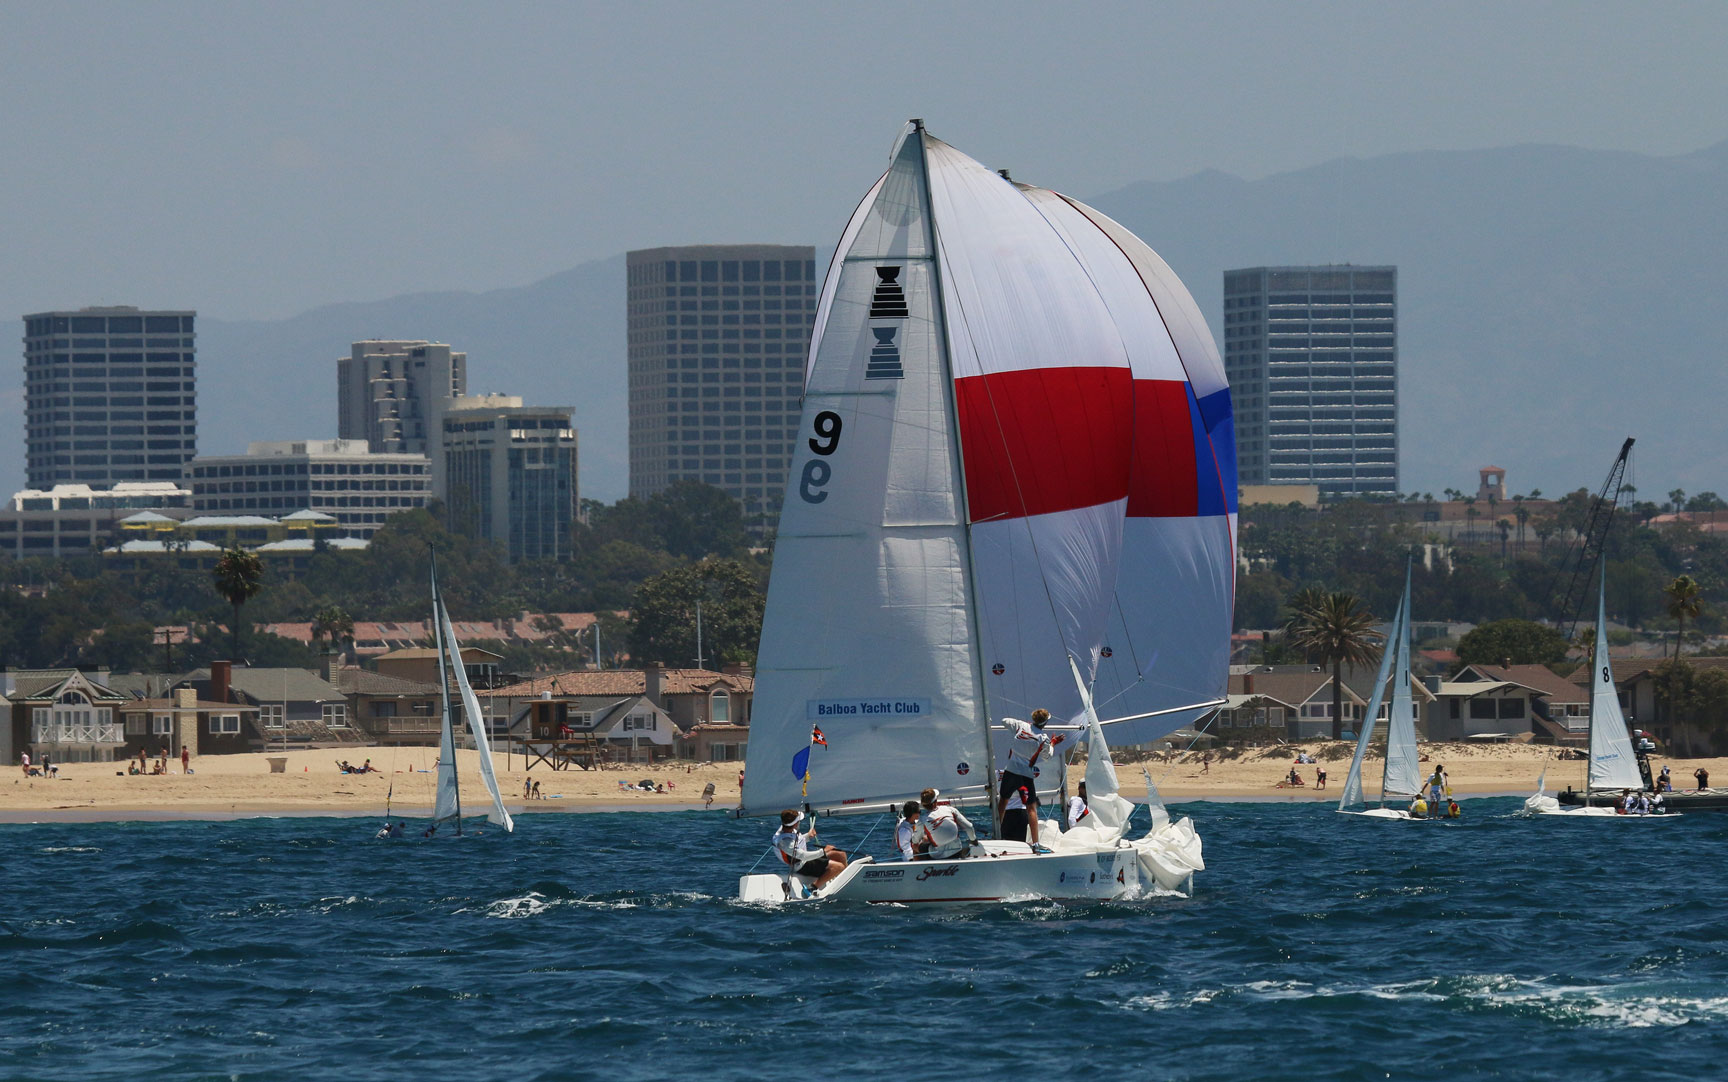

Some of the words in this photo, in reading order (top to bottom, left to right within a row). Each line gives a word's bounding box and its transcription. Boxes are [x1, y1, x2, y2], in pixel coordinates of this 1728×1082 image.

[808, 410, 843, 456] 9
[1602, 666, 1610, 683] 8
[818, 703, 857, 715] Balboa
[860, 702, 892, 714] Yacht
[894, 702, 920, 714] Club
[540, 726, 550, 737] 10
